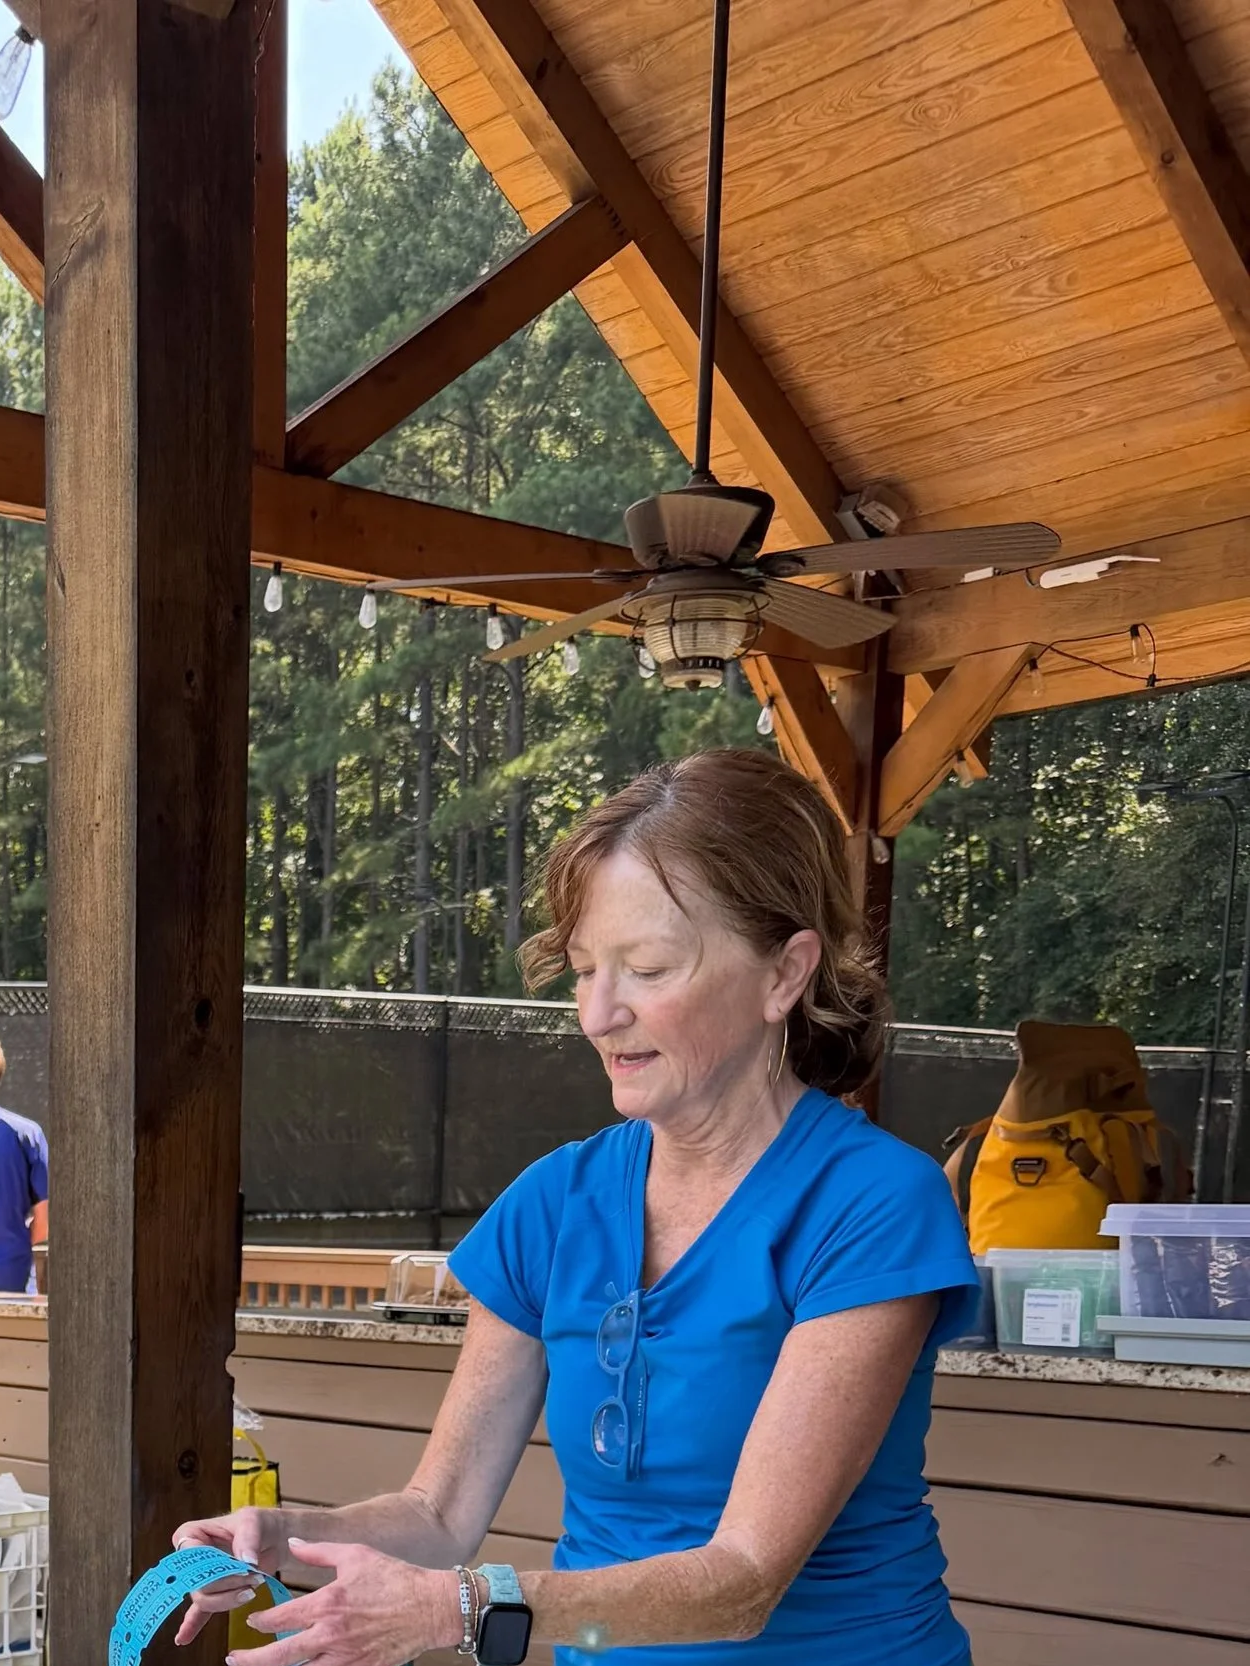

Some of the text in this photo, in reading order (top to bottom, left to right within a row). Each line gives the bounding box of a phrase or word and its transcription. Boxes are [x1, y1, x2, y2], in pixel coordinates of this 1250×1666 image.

[190, 1564, 240, 1587] TICKET
[125, 1580, 154, 1619] COUPON
[140, 1595, 178, 1641] TICKET
